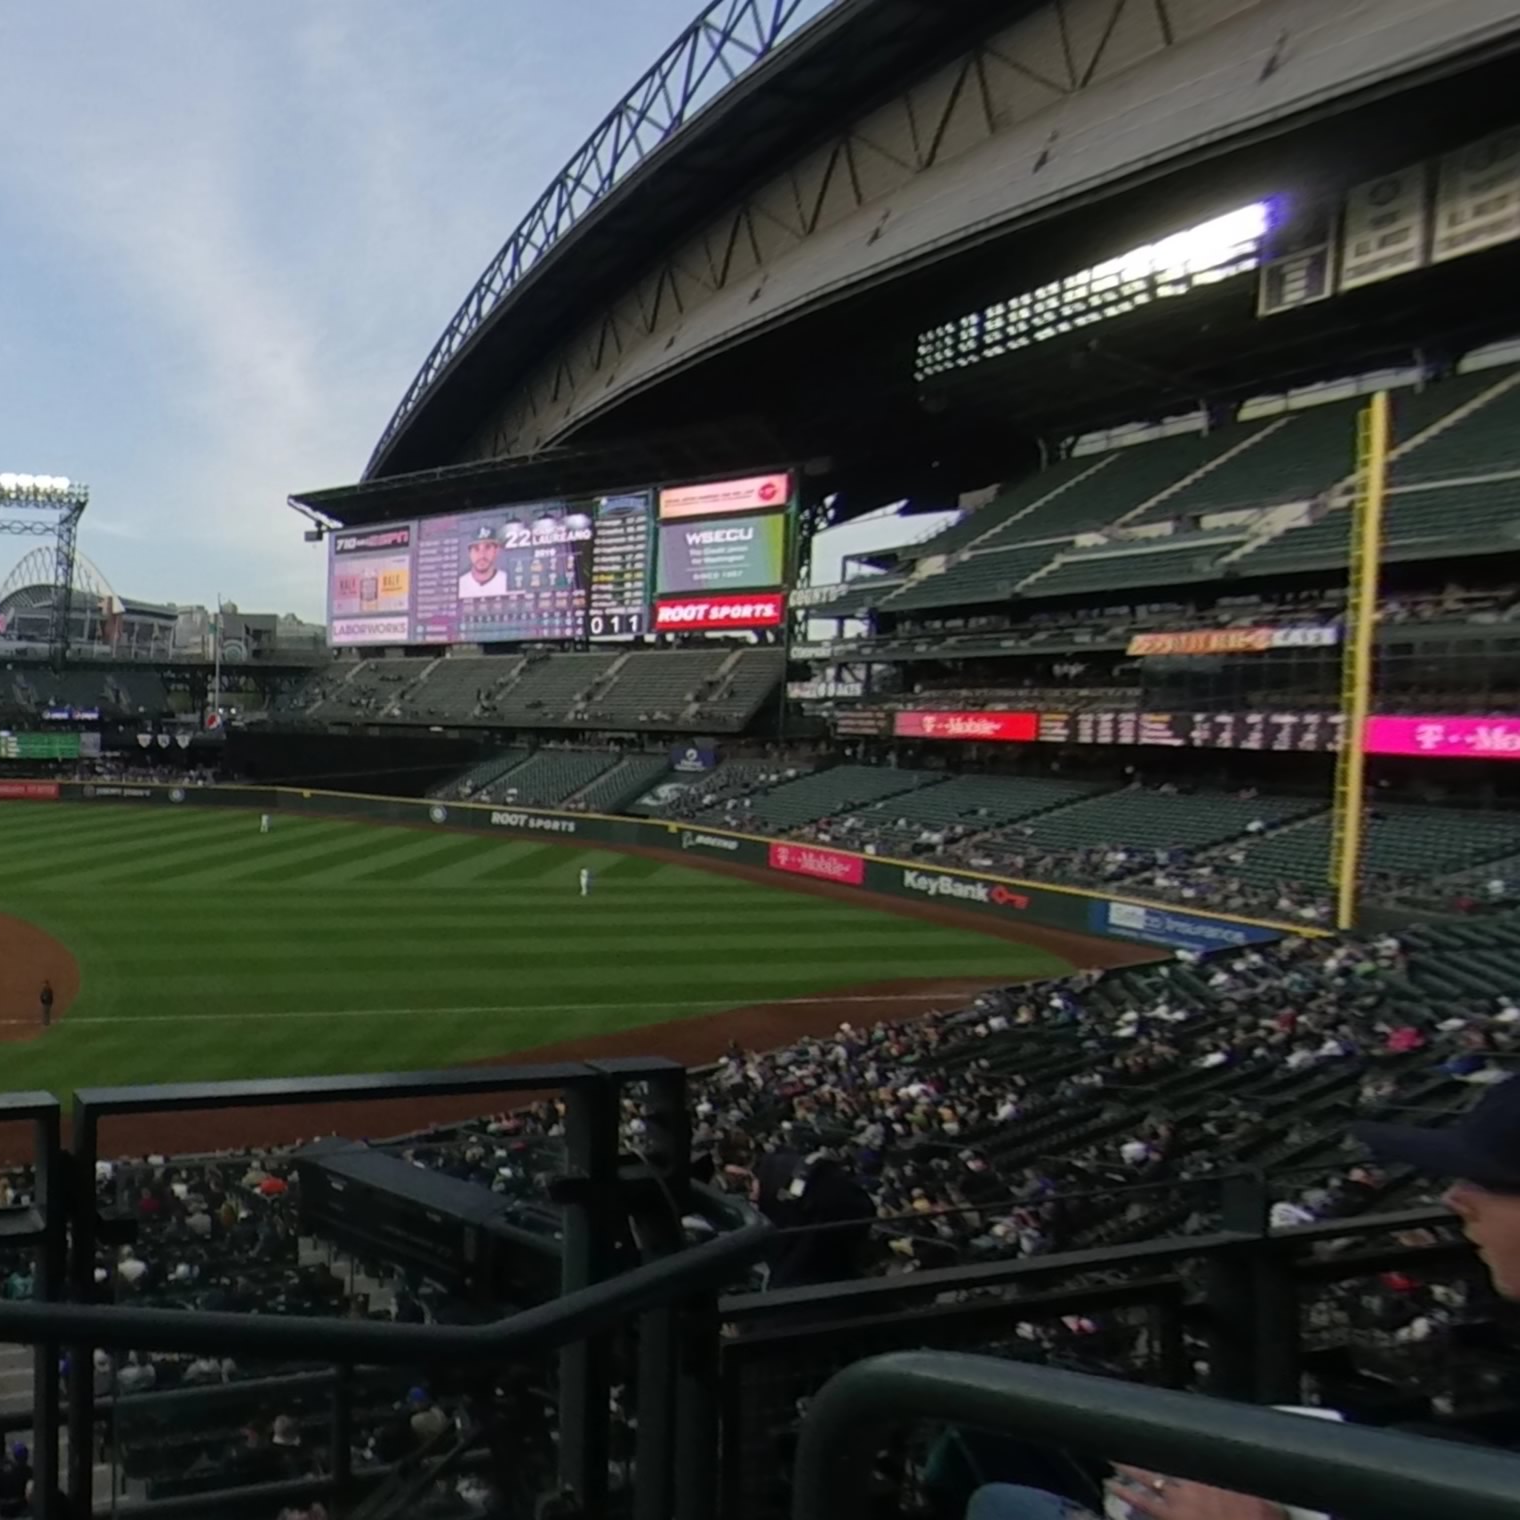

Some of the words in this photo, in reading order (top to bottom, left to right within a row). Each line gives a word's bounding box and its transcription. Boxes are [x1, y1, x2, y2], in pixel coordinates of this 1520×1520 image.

[336, 537, 355, 551] 710
[505, 529, 531, 549] 22
[532, 529, 591, 545] LAUREANO
[685, 528, 753, 546] WSECU
[657, 604, 709, 623] ROOT
[709, 603, 774, 620] SPORTS
[334, 623, 406, 637] LABORWORKS
[491, 811, 527, 828] ROOT
[528, 817, 576, 833] SPORTS
[695, 834, 739, 851] BOEING
[903, 869, 990, 903] KeyBank
